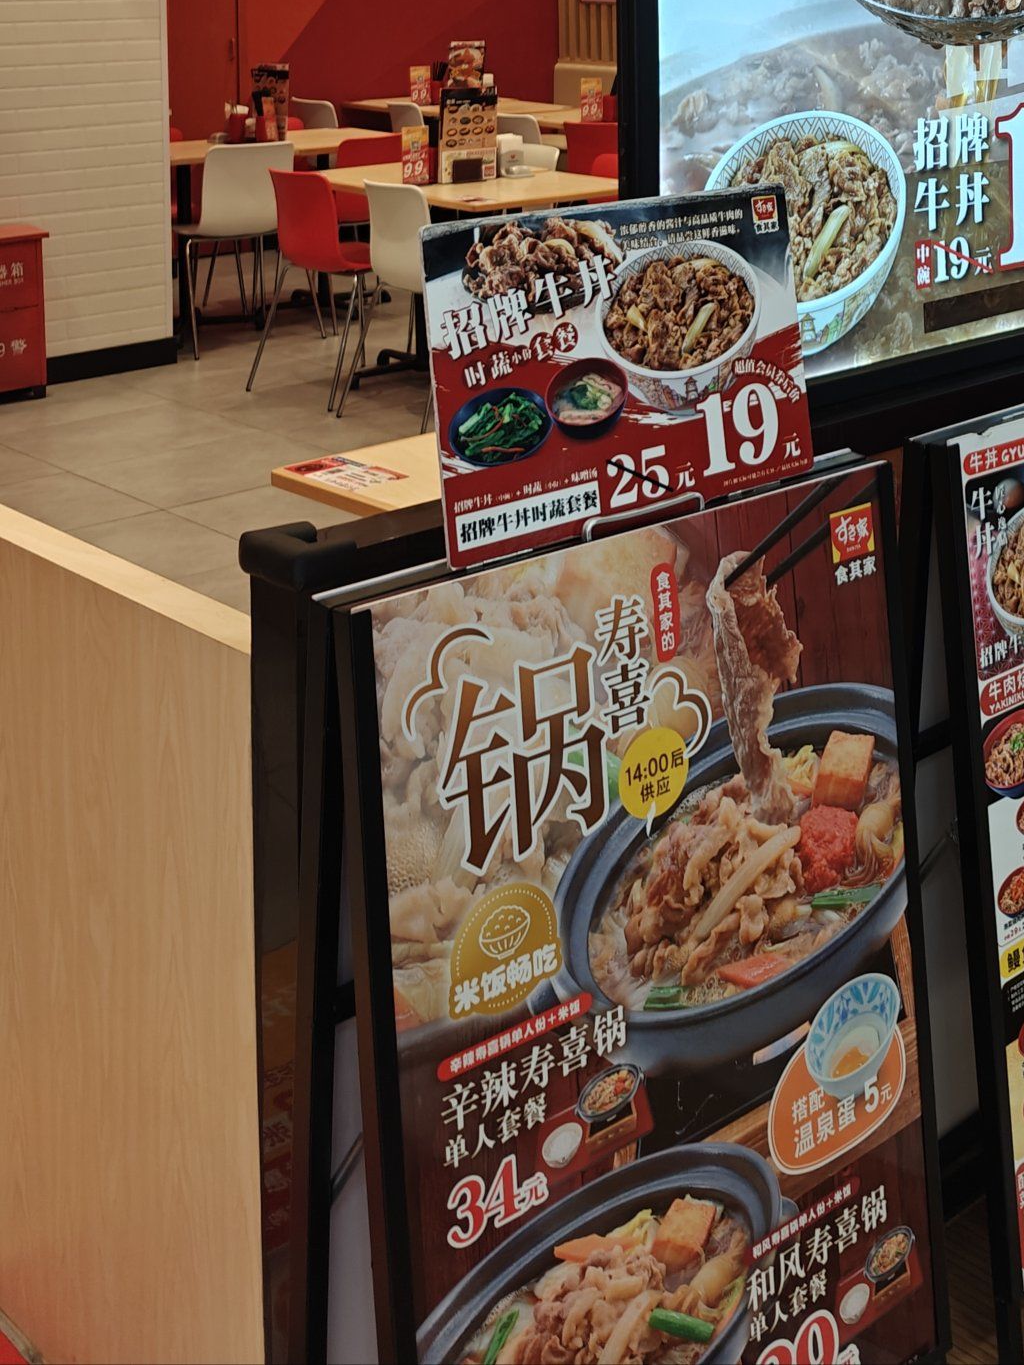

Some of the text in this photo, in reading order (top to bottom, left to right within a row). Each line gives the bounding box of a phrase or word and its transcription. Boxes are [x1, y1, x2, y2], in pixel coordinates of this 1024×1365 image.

[912, 112, 989, 171] 招牌
[914, 172, 990, 231] 牛丼
[915, 240, 932, 288] 中碗
[441, 253, 618, 362] 招牌牛丼
[463, 322, 578, 389] 时蔬小份套餐
[969, 446, 999, 473] 牛丼
[459, 488, 599, 545] 招牌牛丼时蔬套餐
[834, 515, 869, 545] すき家
[970, 486, 996, 560] 牛丼
[834, 555, 877, 586] 食其家
[655, 570, 676, 652] 食其家的
[596, 594, 651, 735] 寿喜
[441, 646, 609, 876] 锅
[624, 748, 686, 787] 14:00后
[639, 775, 672, 802] 供应
[452, 943, 560, 1014] 米饭畅吃
[440, 1004, 627, 1132] 辛辣寿喜锅
[443, 1092, 548, 1168] 单人套餐
[790, 1085, 826, 1125] 搭配
[793, 1093, 857, 1158] 温泉蛋
[746, 1184, 889, 1311] 和风寿喜锅
[748, 1269, 828, 1343] 单人套餐
